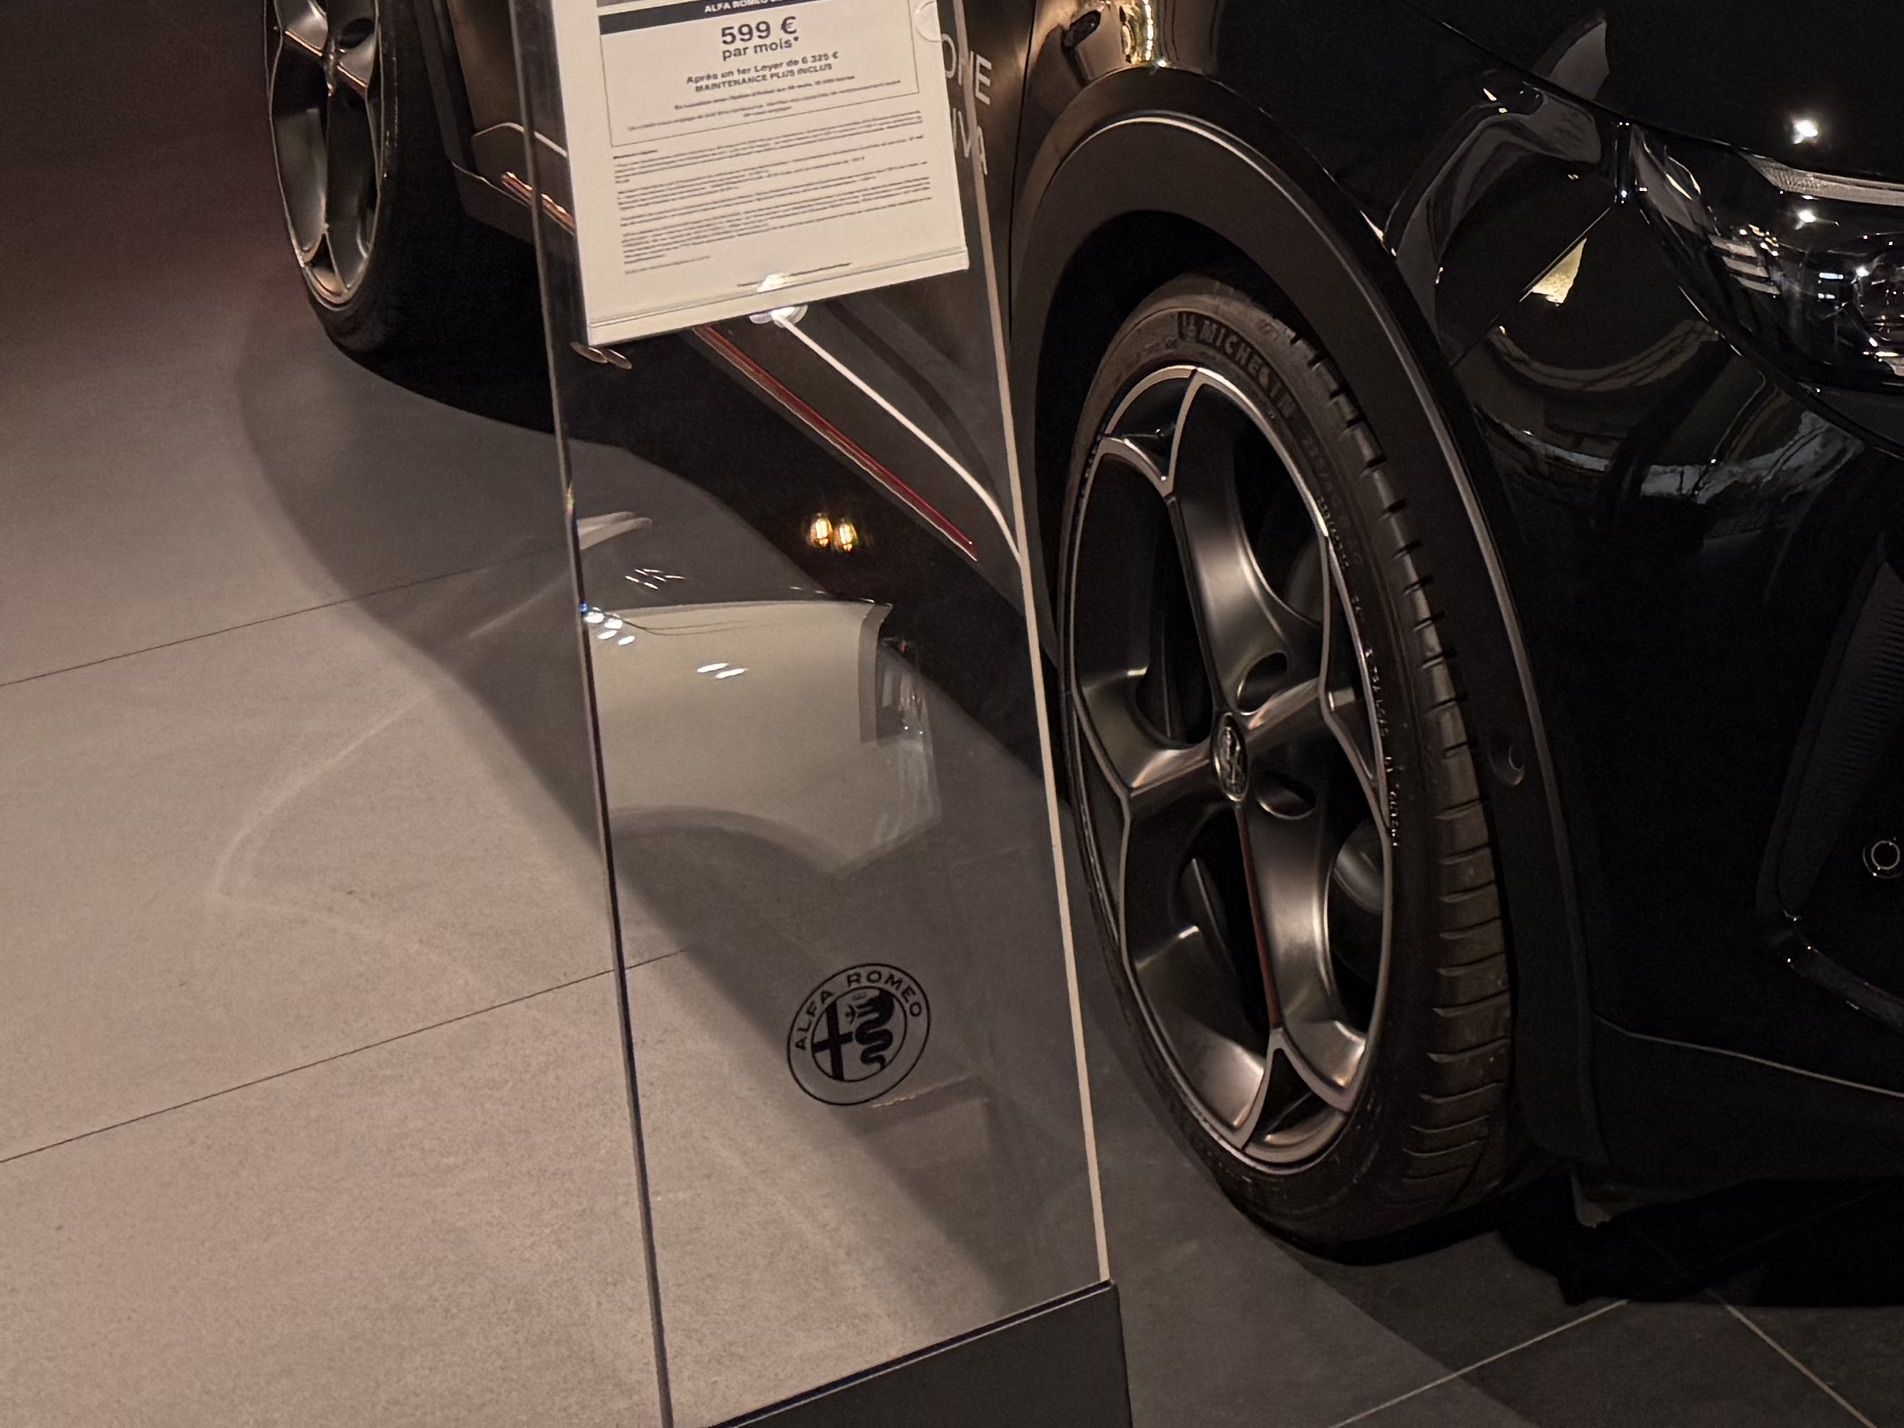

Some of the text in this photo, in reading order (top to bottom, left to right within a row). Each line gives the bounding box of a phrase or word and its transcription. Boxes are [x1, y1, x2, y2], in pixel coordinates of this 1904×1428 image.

[704, 0, 732, 14] ALFA
[720, 15, 798, 45] 599 €
[722, 45, 750, 62] par
[695, 74, 768, 93] MAINTENANCE
[1198, 319, 1298, 420] MICHEIN
[794, 970, 923, 1051] ALFA ROMEO
